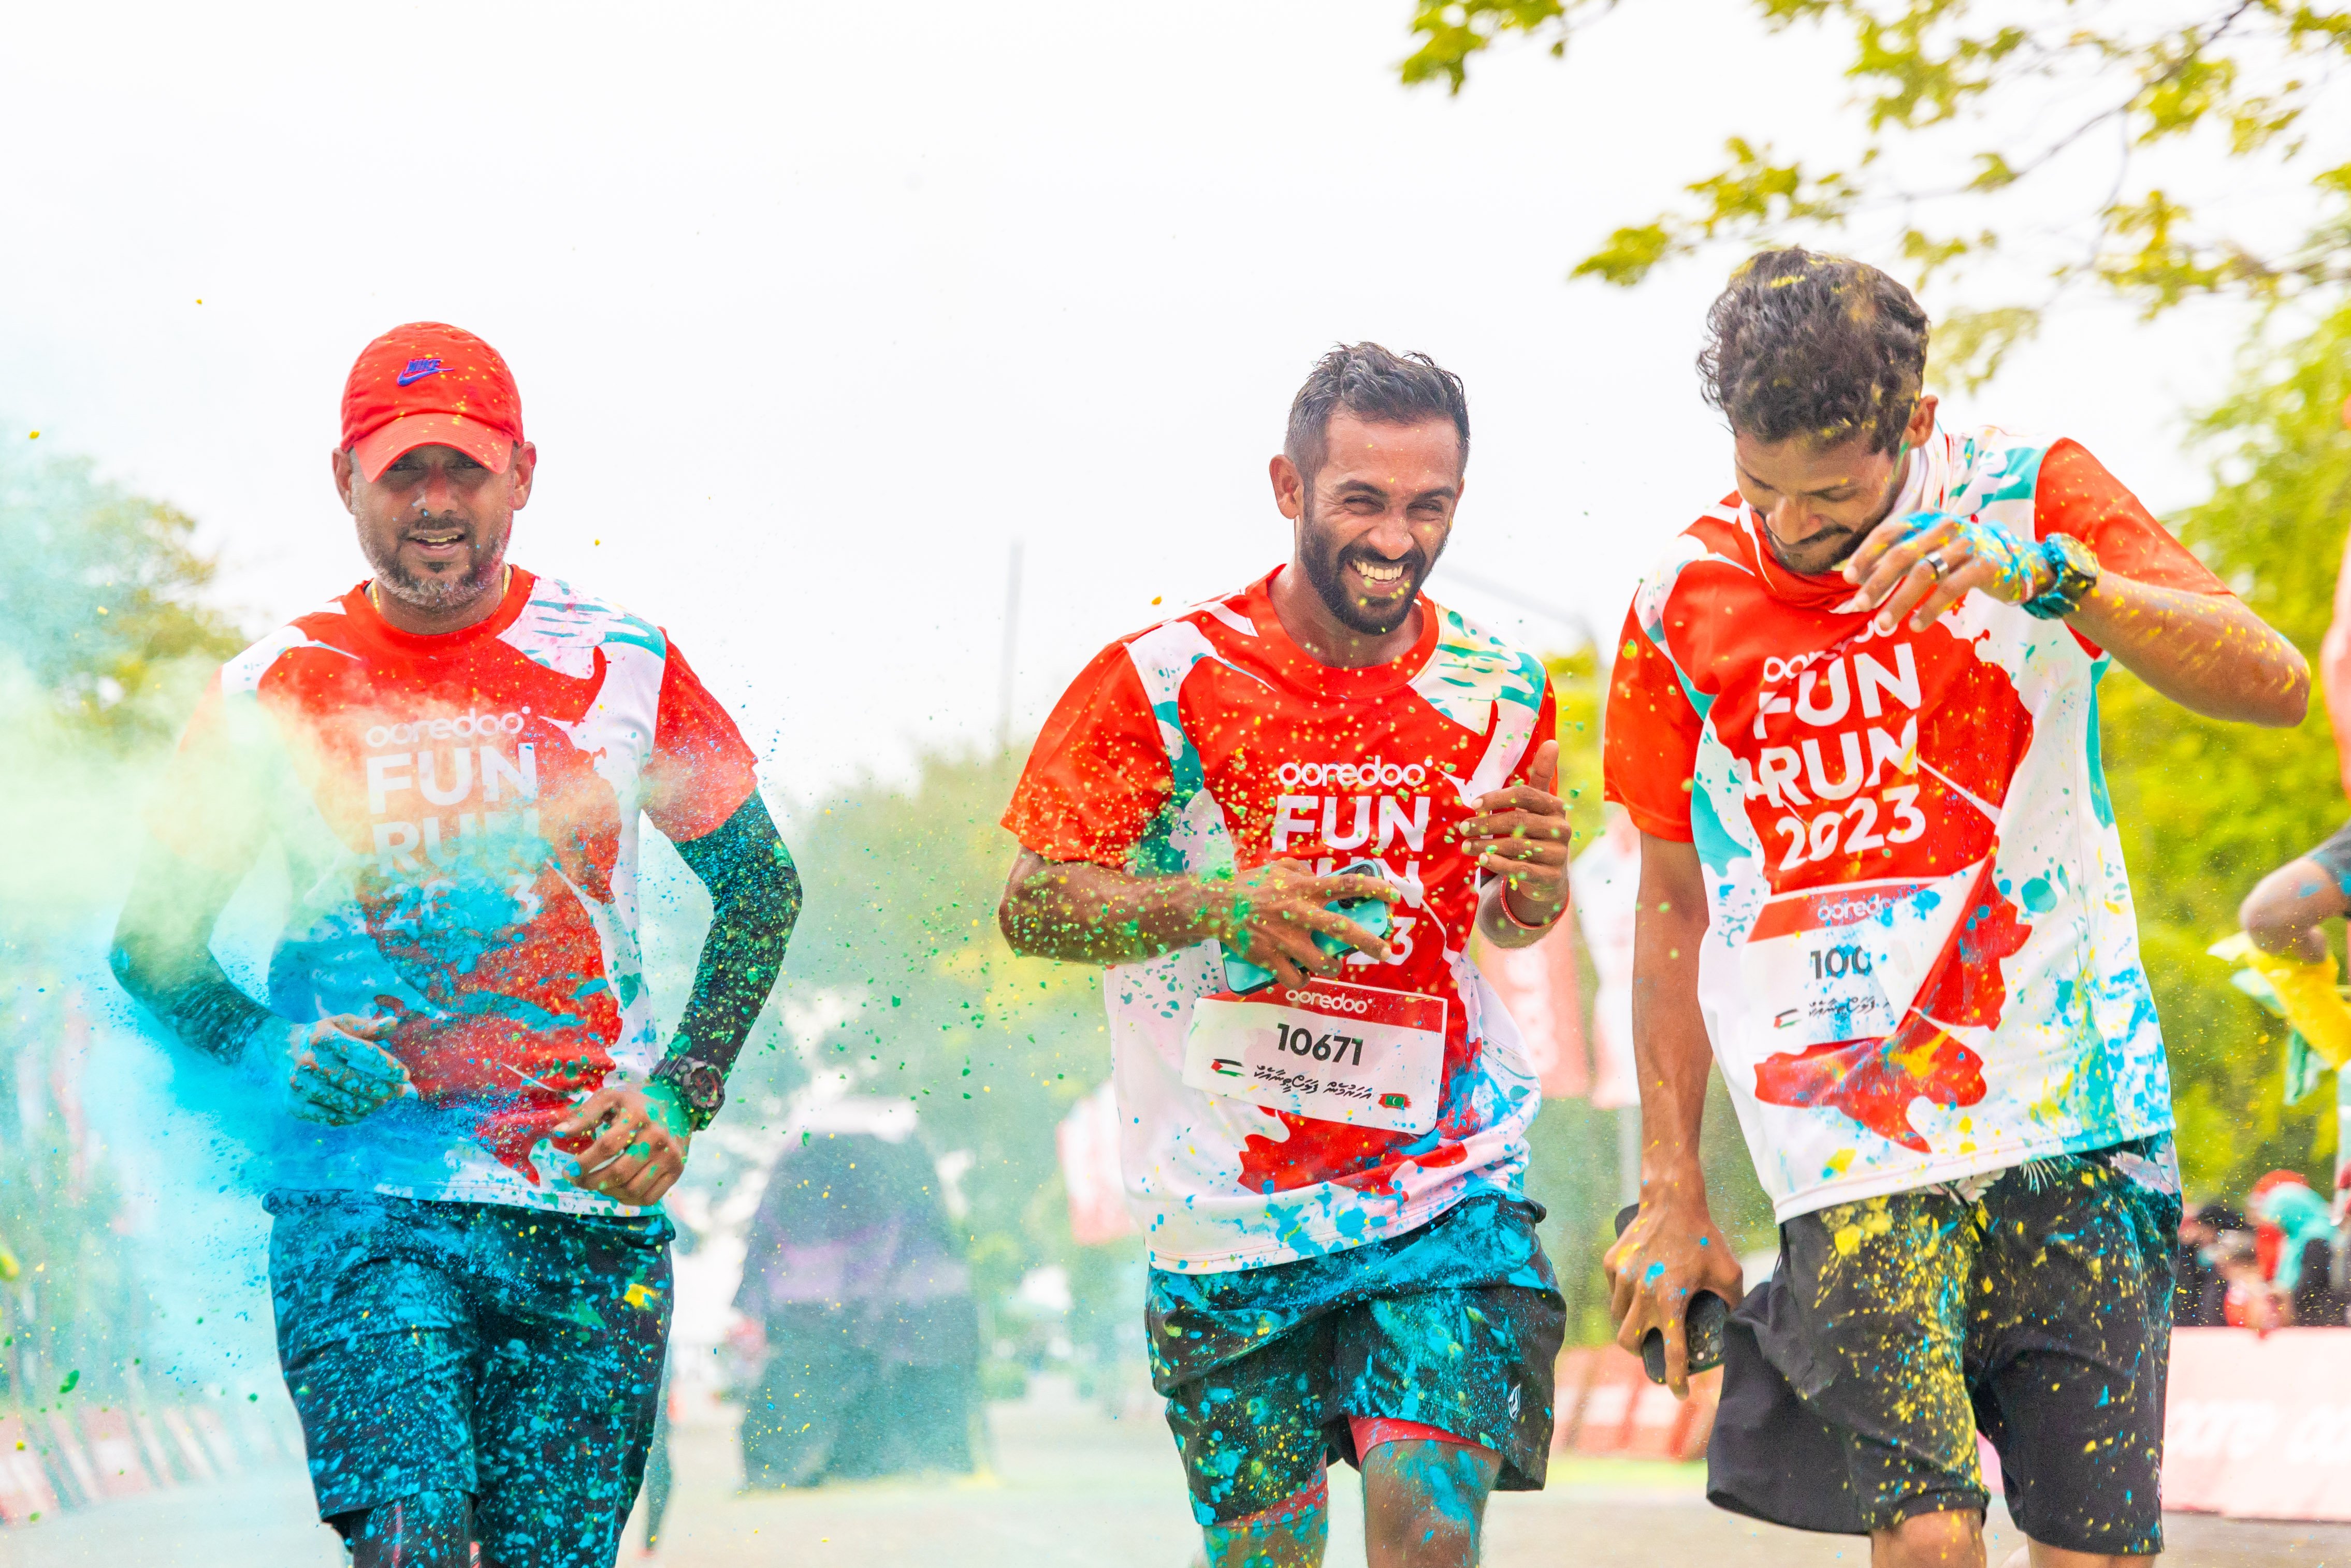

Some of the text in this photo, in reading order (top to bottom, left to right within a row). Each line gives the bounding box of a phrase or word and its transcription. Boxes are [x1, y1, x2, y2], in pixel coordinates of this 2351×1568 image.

[404, 359, 441, 374] NIKE
[1753, 643, 1921, 739] FUN
[366, 707, 525, 747] ooredoo
[366, 743, 539, 815] FUN
[1278, 755, 1426, 787] ooredoo
[1758, 715, 1919, 808] RUN
[1271, 795, 1431, 852] FUN
[1775, 785, 1926, 871] 2023
[381, 873, 540, 932] 203
[1285, 990, 1368, 1014] ooredoo
[1277, 1023, 1363, 1066] 10671
